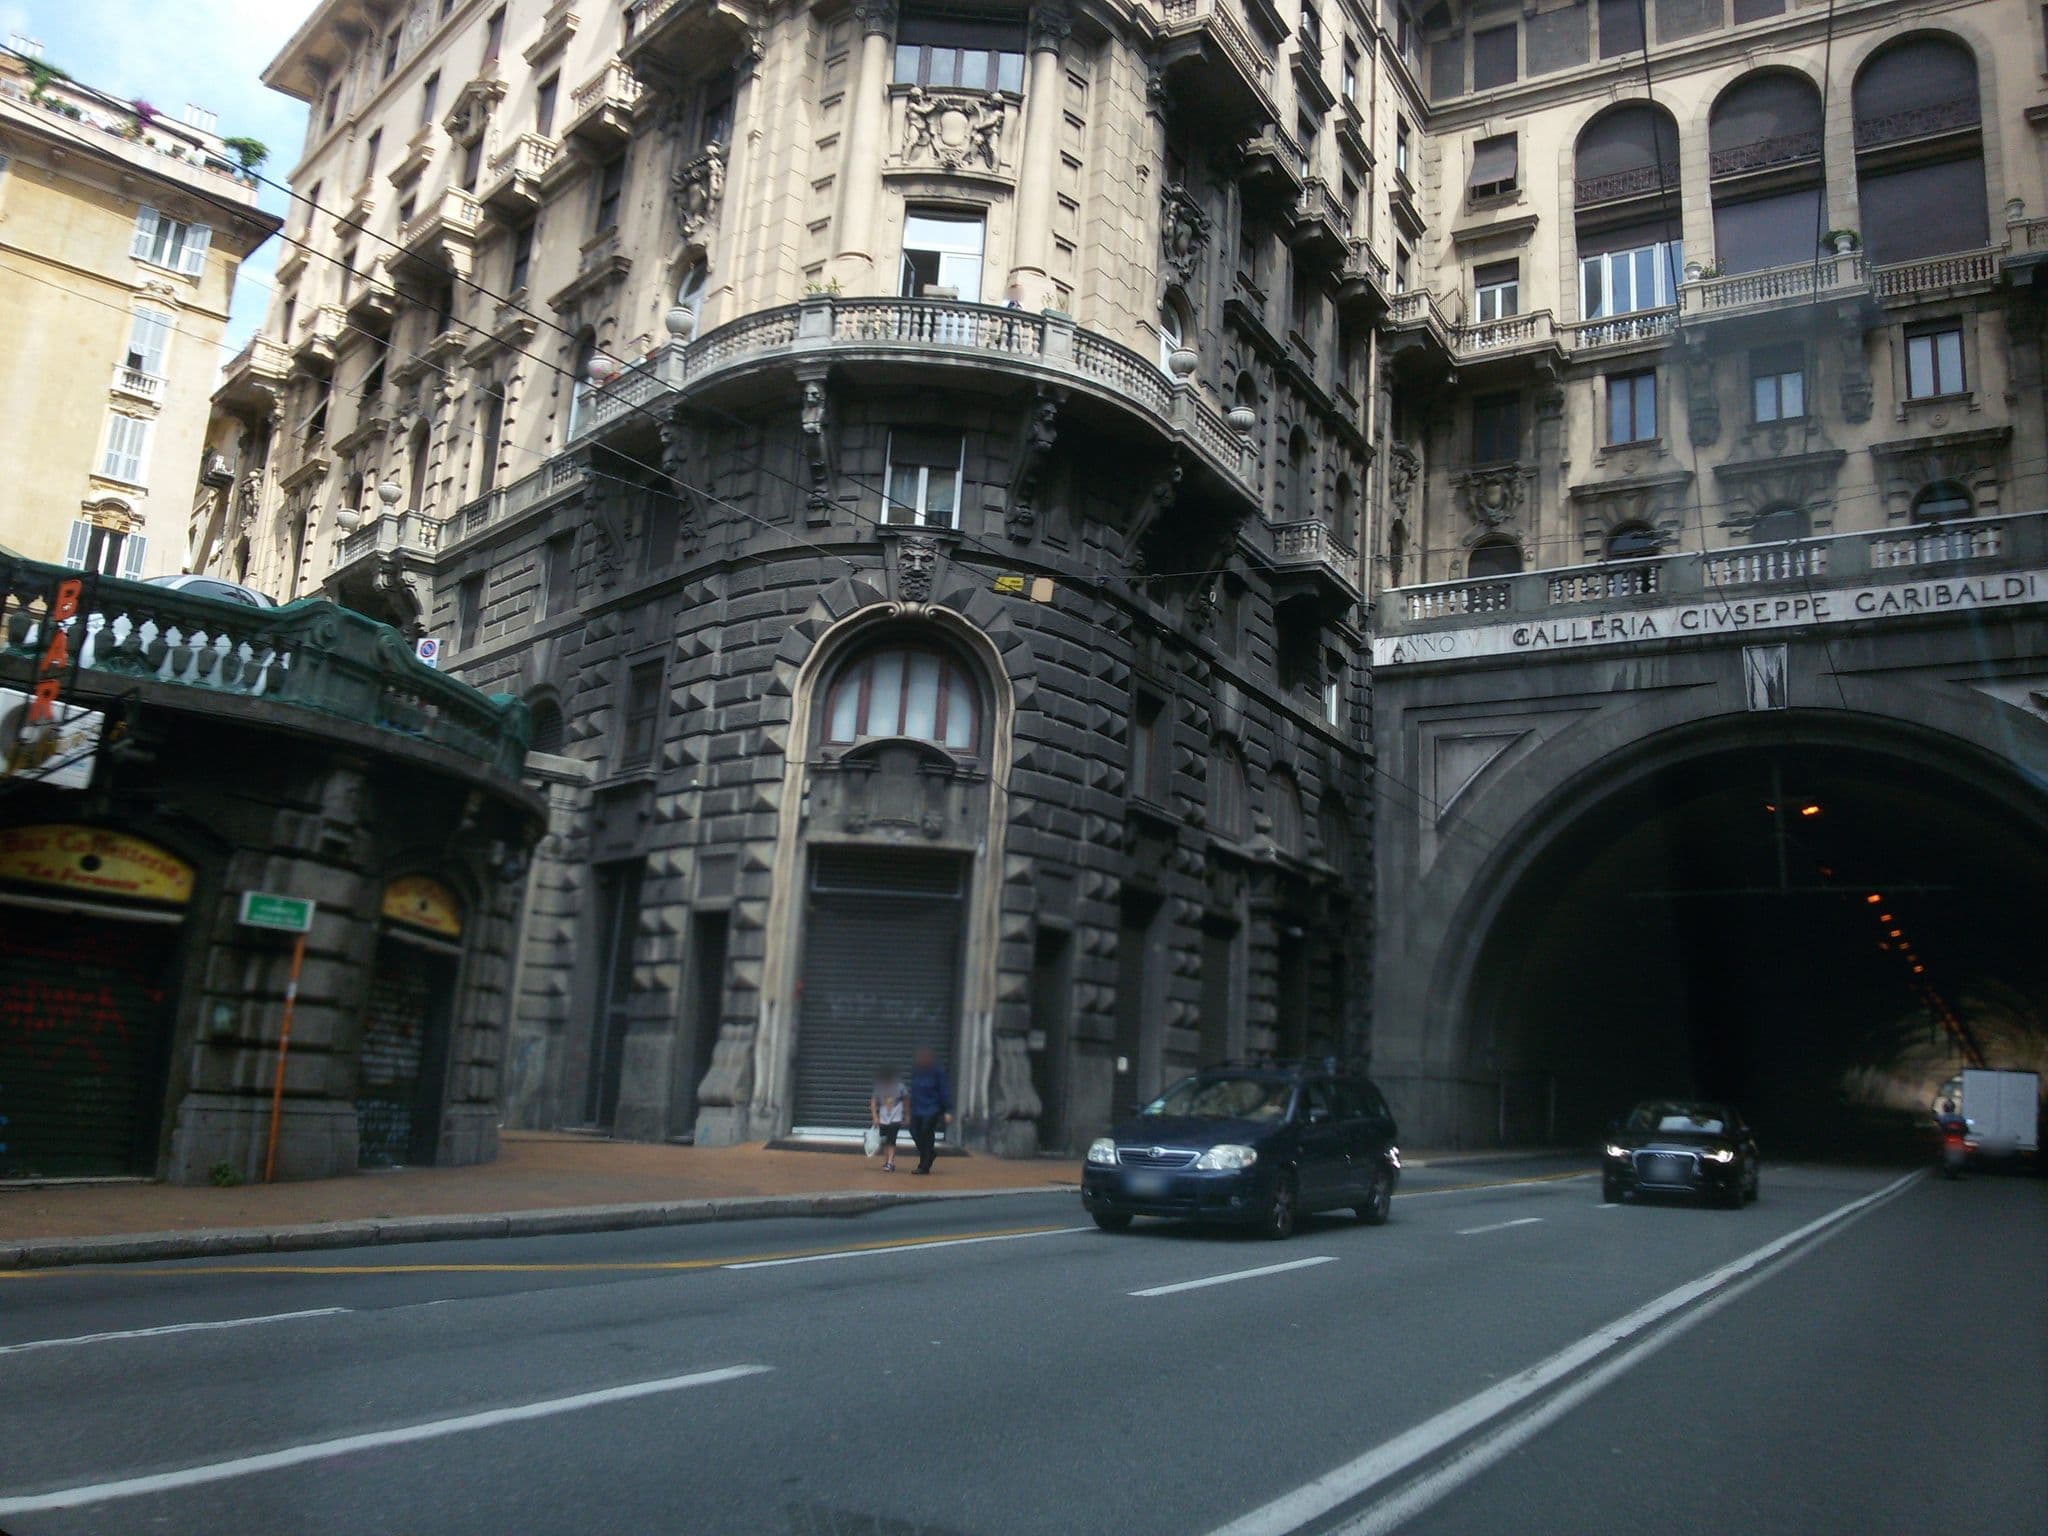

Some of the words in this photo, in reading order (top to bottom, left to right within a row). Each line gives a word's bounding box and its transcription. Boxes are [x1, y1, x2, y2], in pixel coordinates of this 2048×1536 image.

[28, 579, 82, 721] BAR
[1512, 615, 1658, 647] GALLERIA
[1854, 575, 2036, 613] GARIBALDI
